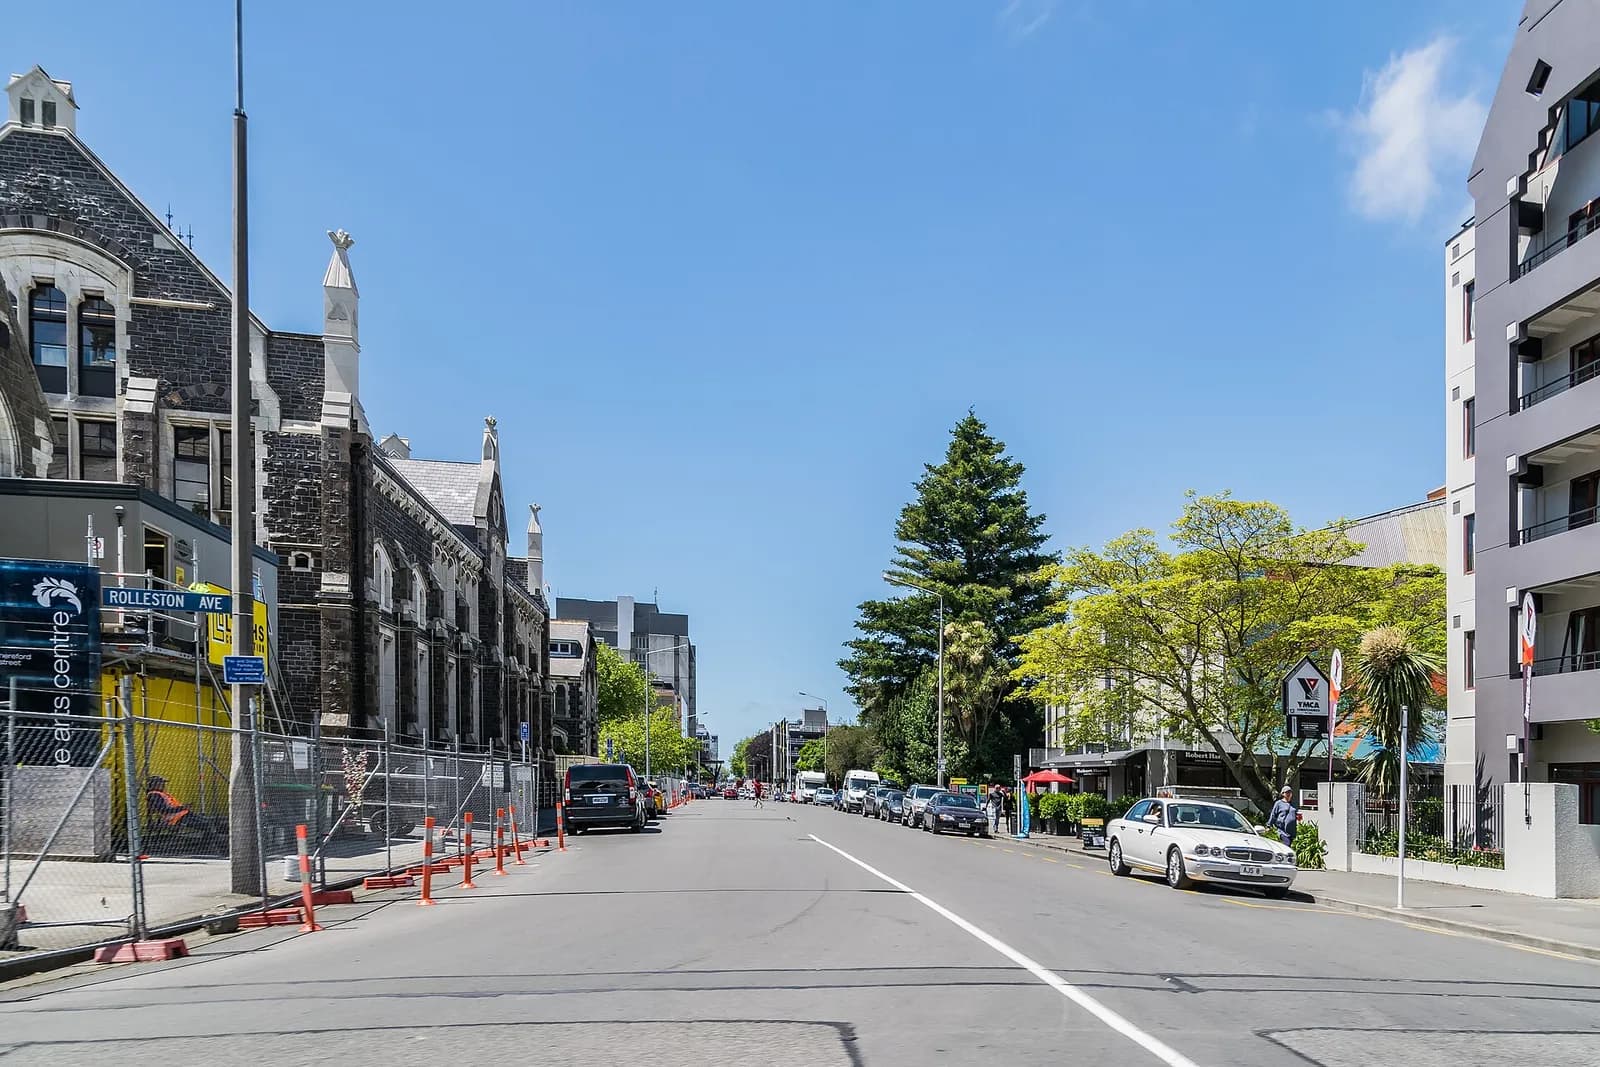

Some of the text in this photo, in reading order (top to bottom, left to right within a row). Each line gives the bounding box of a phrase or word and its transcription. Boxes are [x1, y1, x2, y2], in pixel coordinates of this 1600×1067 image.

[109, 590, 223, 610] ROLLESTON AVE
[49, 611, 70, 688] centre
[1297, 701, 1320, 709] YMCA
[54, 696, 70, 741] arts
[1185, 751, 1209, 759] Robert
